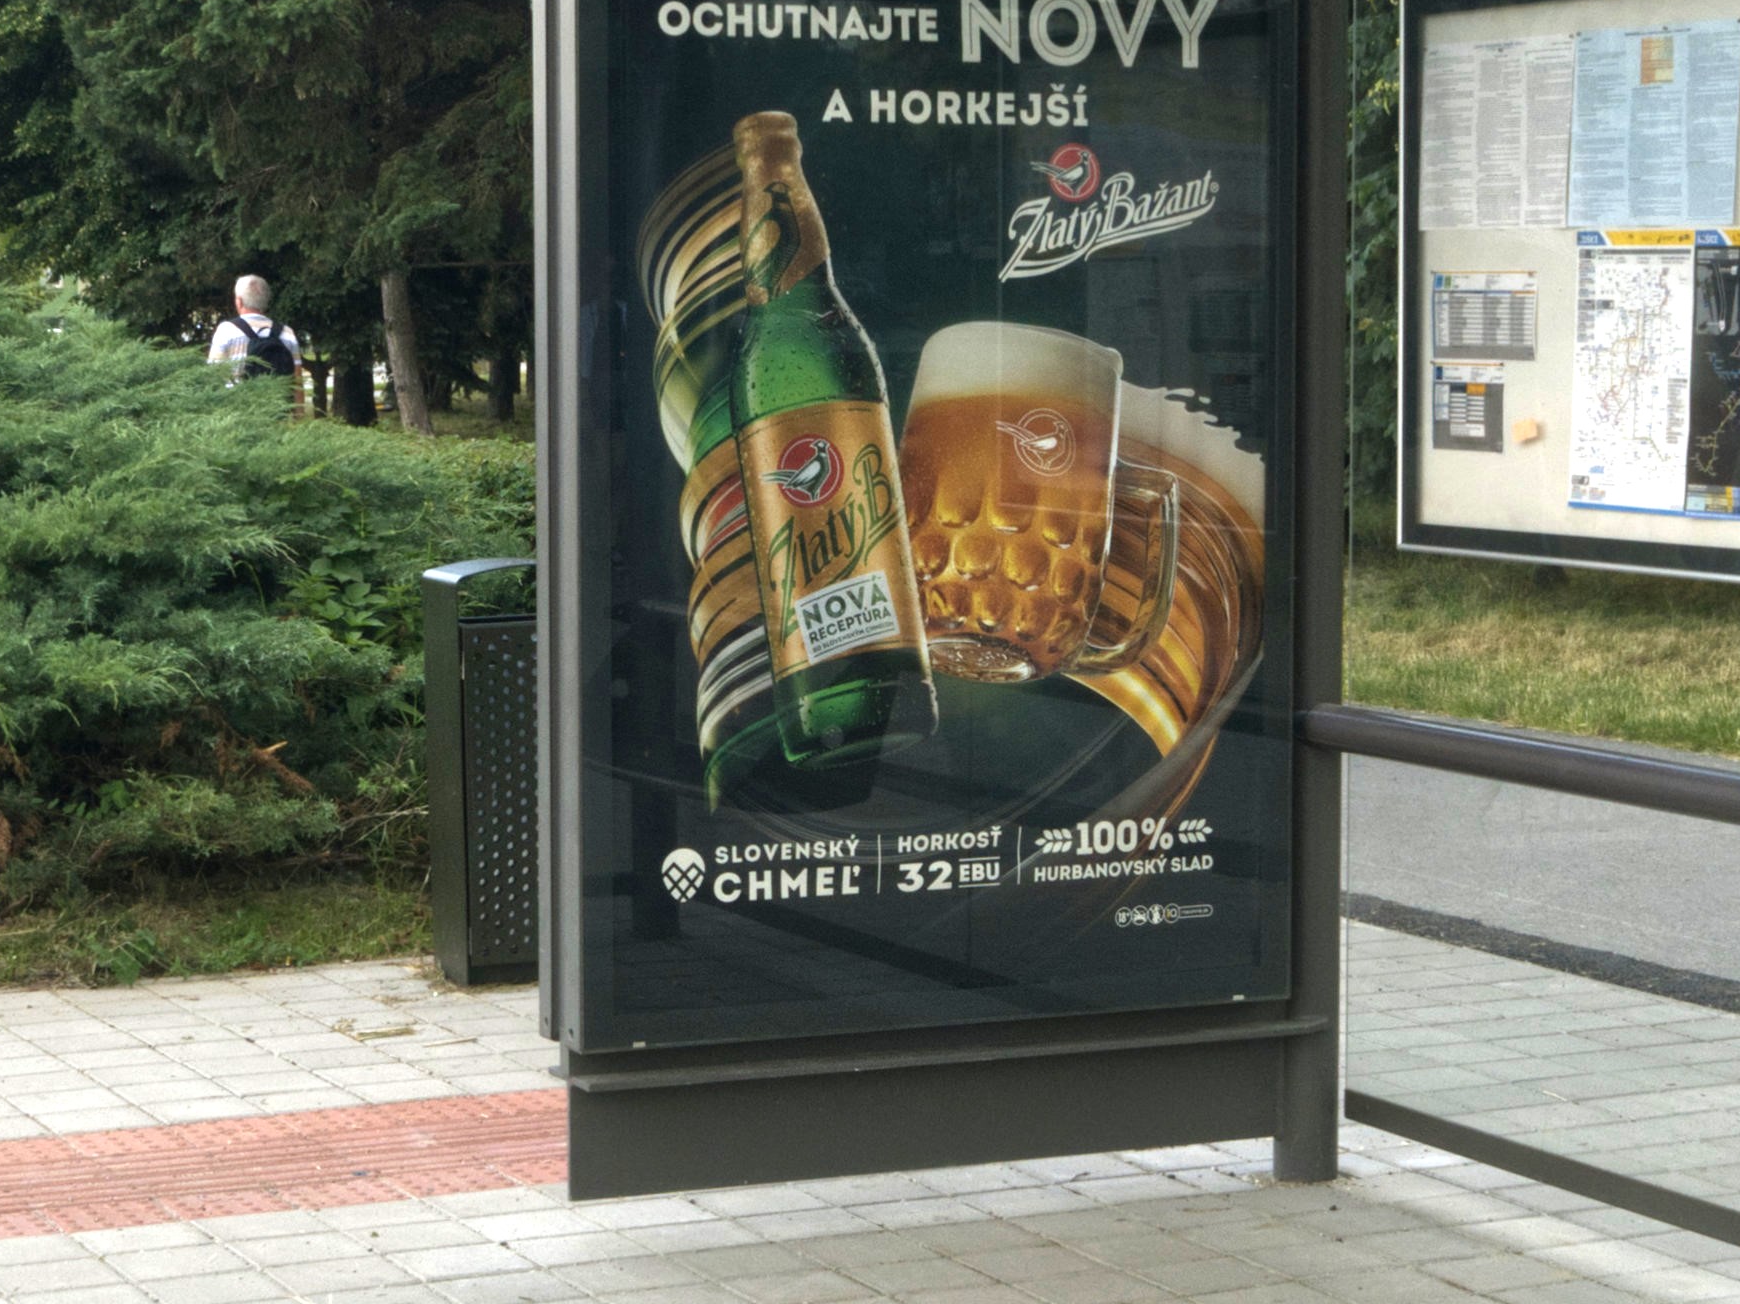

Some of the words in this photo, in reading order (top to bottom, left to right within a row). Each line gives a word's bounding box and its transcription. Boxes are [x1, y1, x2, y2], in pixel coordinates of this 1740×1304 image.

[658, 1, 938, 41] OCHUTNAJTE
[823, 89, 852, 122] A
[871, 84, 1088, 127] HORKEJŠÍ
[998, 196, 1103, 283] Zlatý
[1085, 170, 1215, 261] Bažant
[768, 492, 867, 648] Zlatý
[802, 574, 888, 630] NOVÁ
[809, 605, 892, 644] RECEPTÚRA
[716, 834, 859, 864] SLOVENSKÝ
[898, 828, 1002, 854] HORKOSŤ
[1076, 817, 1174, 856] 100%
[714, 865, 860, 902] CHMEĽ
[898, 861, 952, 892] 32
[959, 862, 1000, 882] EBU
[1033, 854, 1166, 882] HURBANOVSKÝ
[1171, 855, 1214, 872] SLAD
